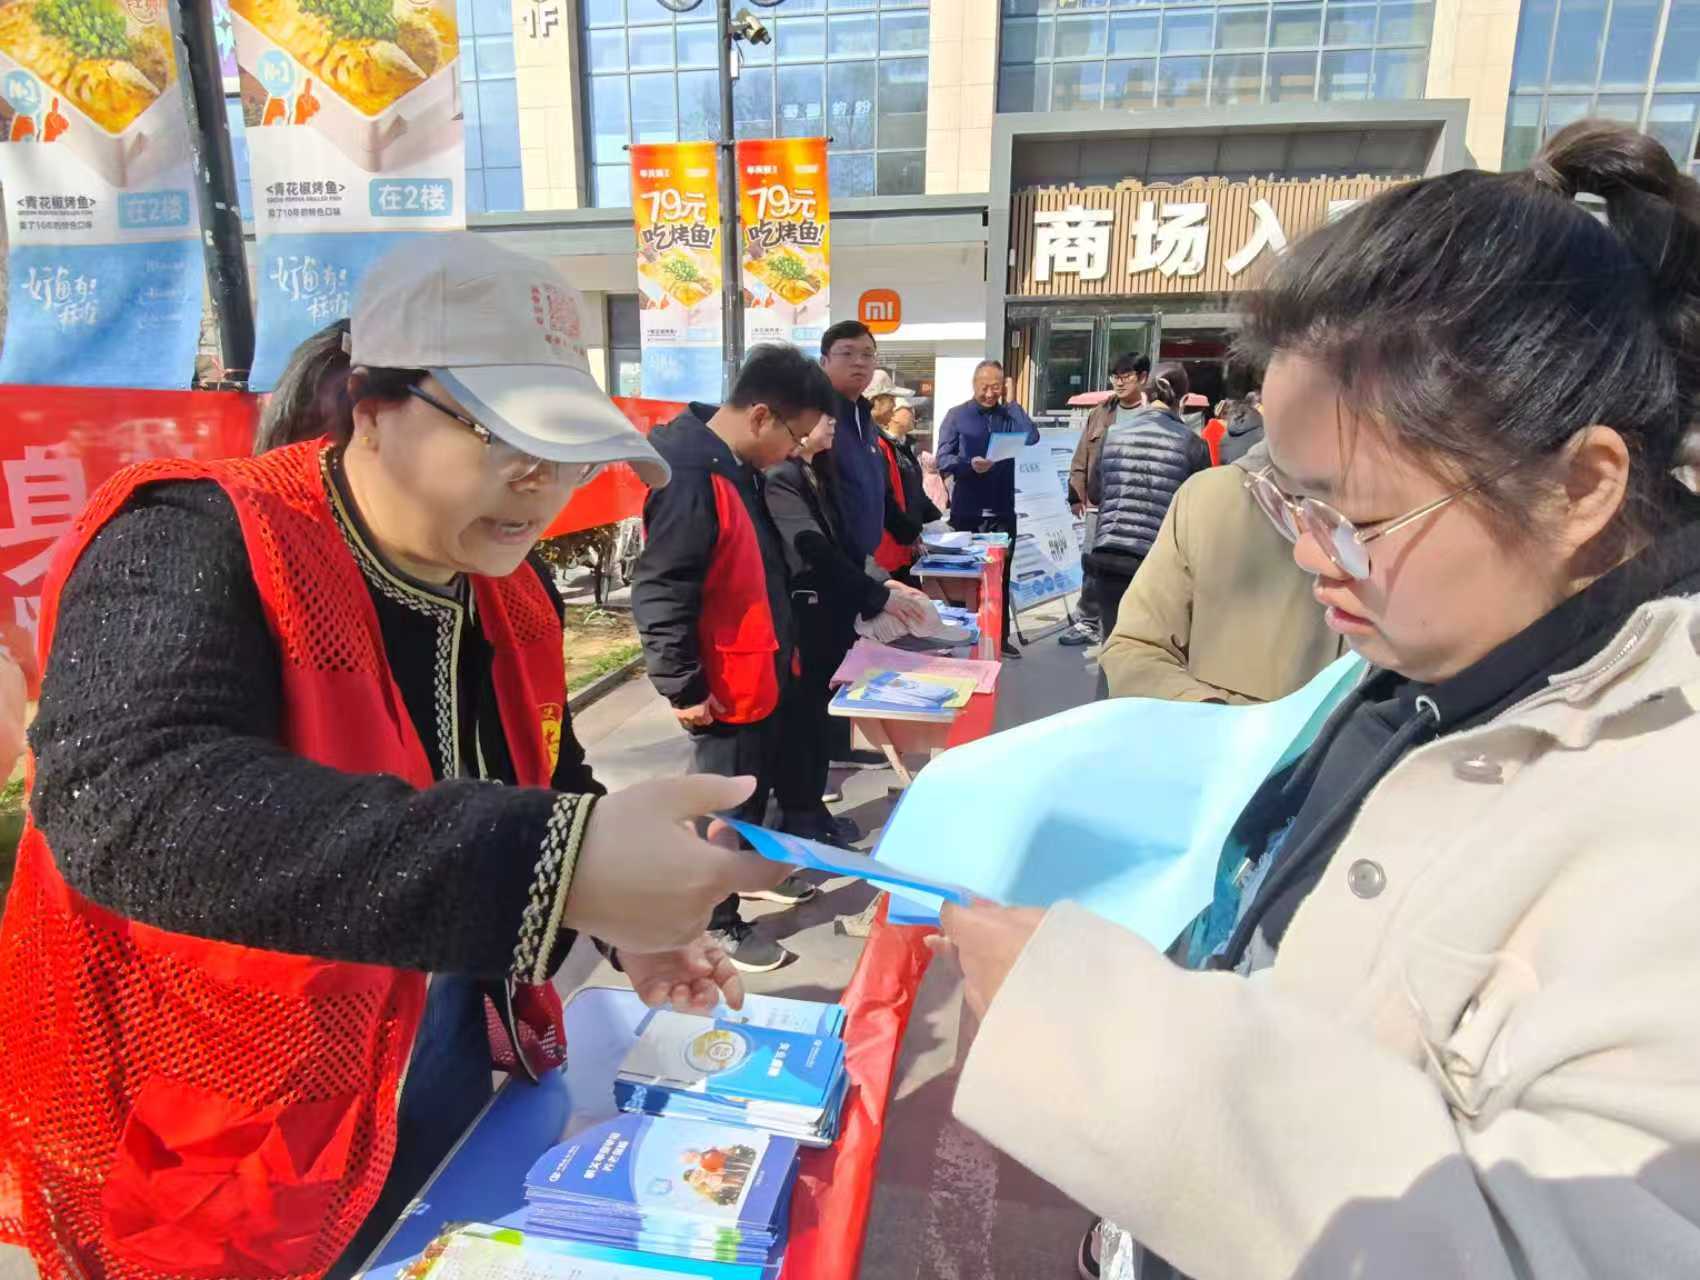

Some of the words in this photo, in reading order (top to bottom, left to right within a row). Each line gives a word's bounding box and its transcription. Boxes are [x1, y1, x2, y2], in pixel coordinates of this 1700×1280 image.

[378, 184, 446, 211] 在2楼
[640, 188, 707, 222] 79元
[746, 184, 817, 220] 79元
[1034, 197, 1364, 282] 商场入
